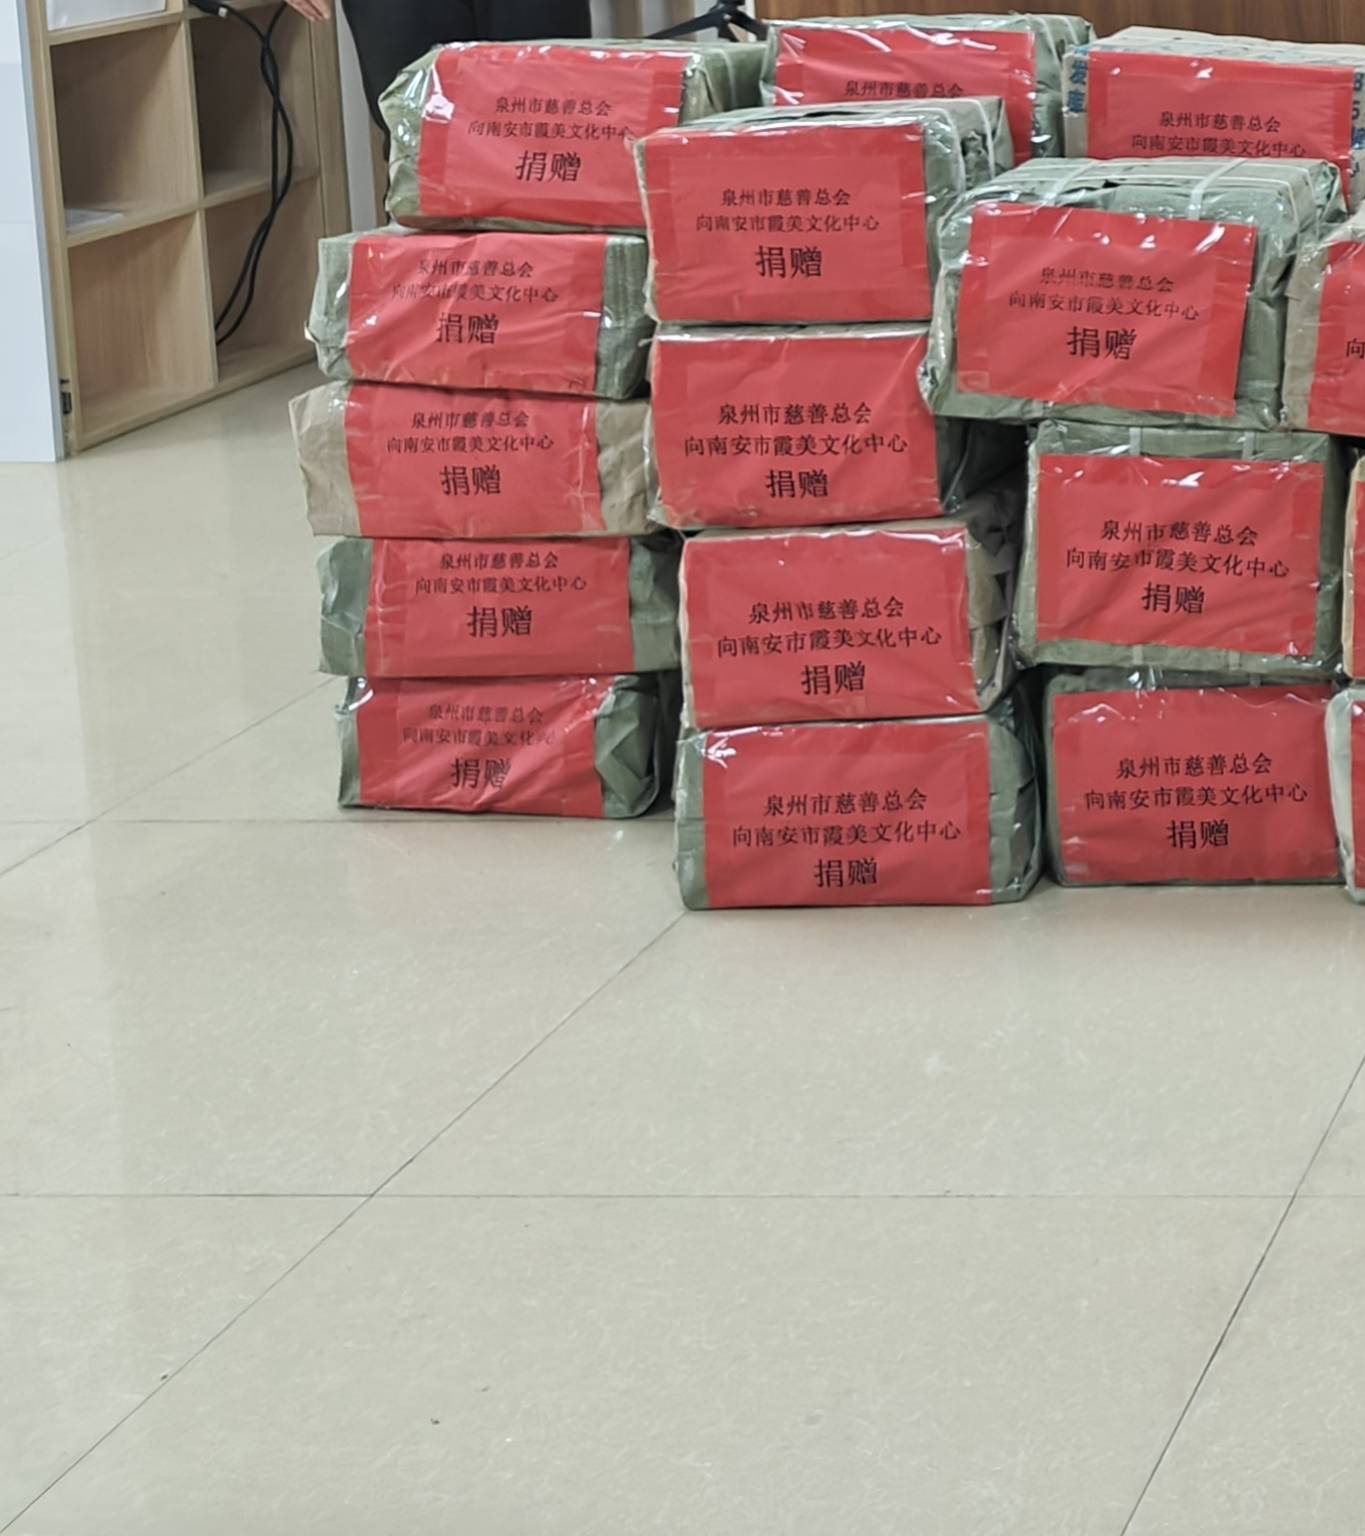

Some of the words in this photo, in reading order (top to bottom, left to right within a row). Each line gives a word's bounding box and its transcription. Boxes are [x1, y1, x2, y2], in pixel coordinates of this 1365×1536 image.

[495, 97, 612, 117] 泉州市慈善总会
[1159, 112, 1281, 134] 泉州市慈善总会
[515, 149, 581, 183] 捐赠
[721, 188, 851, 206] 泉州市慈善总会
[696, 215, 879, 232] 向南安市霞美文化中心
[755, 244, 822, 278] 捐赠
[1039, 266, 1175, 293] 泉州市慈善总会
[1008, 292, 1200, 321] 向南安市霞美文化中心
[435, 312, 499, 345] 捐赠
[1066, 327, 1138, 360] 捐赠
[411, 411, 529, 429] 泉州市慈善总会
[718, 401, 872, 425] 泉州市慈善总会
[386, 434, 554, 453] 向南安市霞美文化中心
[684, 433, 908, 457] 向南安市霞美文化中心
[440, 464, 502, 496] 捐赠
[765, 469, 829, 498] 捐赠
[1101, 519, 1258, 546] 泉州市慈善总会
[440, 551, 559, 570] 泉州市慈善总会
[1065, 547, 1290, 579] 向南安市霞美文化中心
[415, 575, 587, 594] 向南安市霞美文化中心
[1140, 581, 1205, 615] 捐赠
[466, 605, 533, 638] 捐赠
[748, 596, 904, 624] 泉州市慈善总会
[717, 626, 942, 658] 向南安市霞美文化中心
[800, 661, 865, 695] 捐赠
[1117, 752, 1273, 778] 泉州市慈善总会
[763, 787, 927, 817] 泉州市慈善总会
[1084, 780, 1308, 811] 向南安市霞美文化中心
[732, 820, 961, 848] 向南安市霞美文化中心
[1166, 820, 1230, 850] 捐赠
[814, 858, 878, 888] 捐赠
